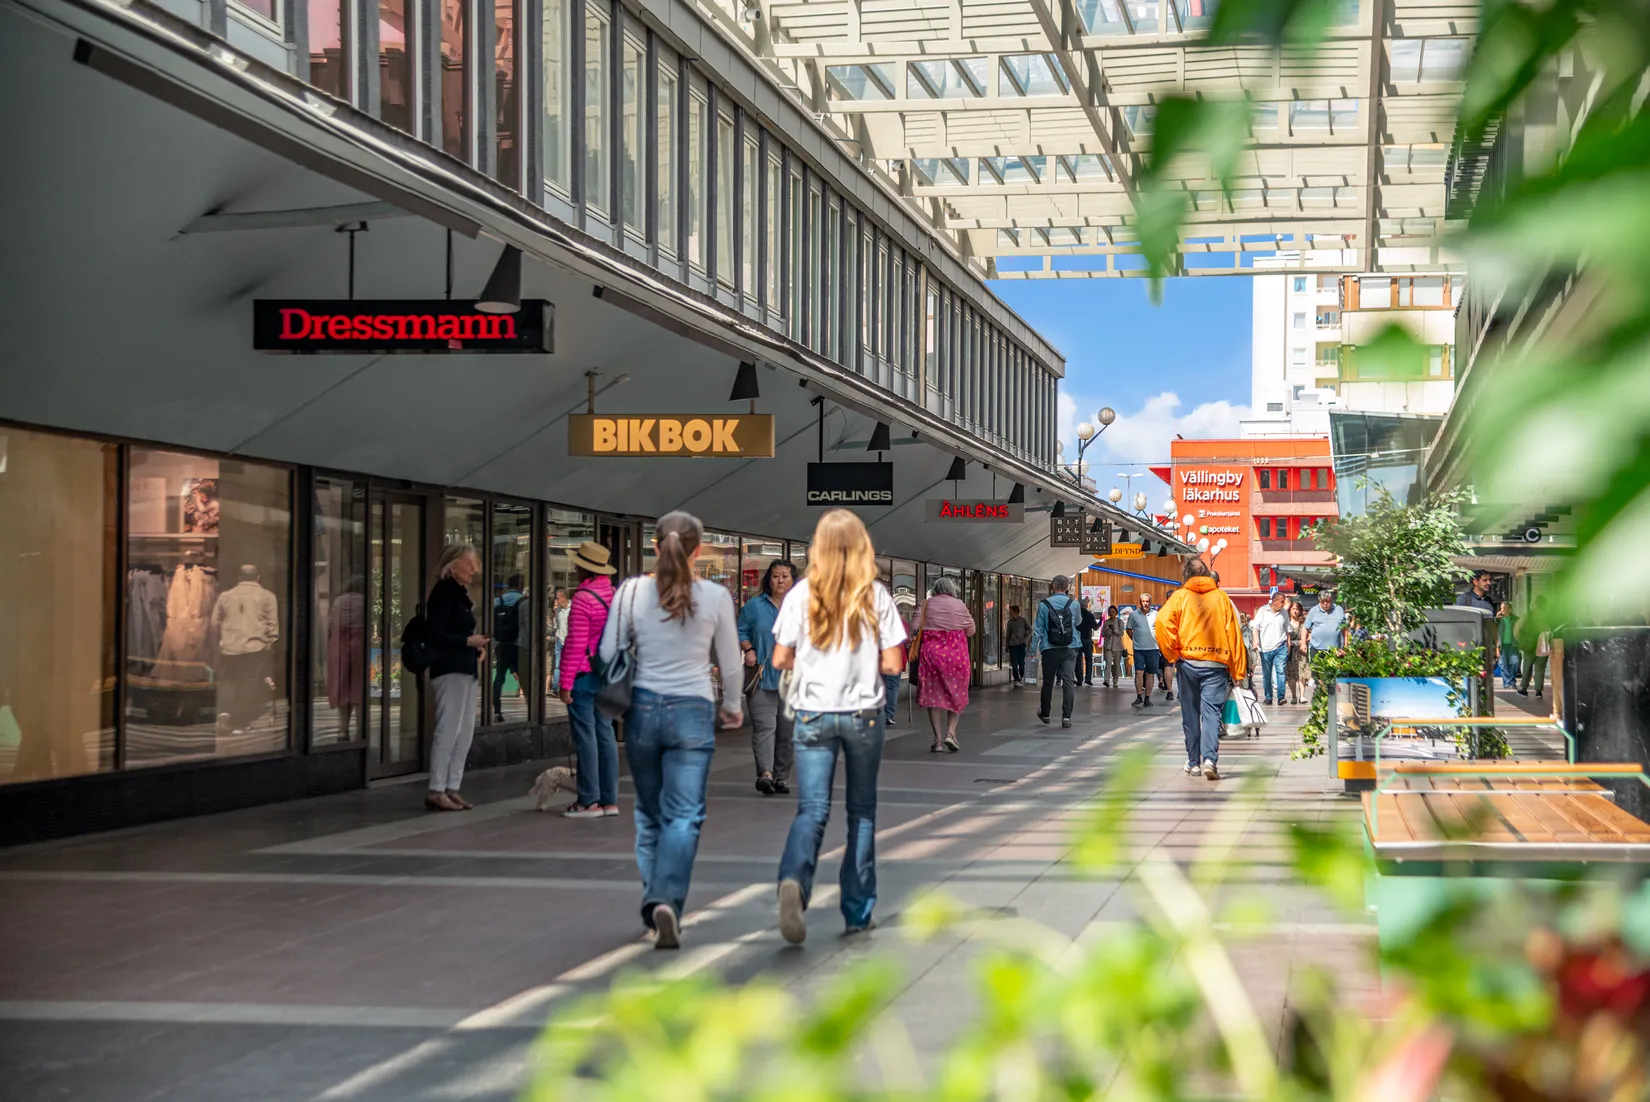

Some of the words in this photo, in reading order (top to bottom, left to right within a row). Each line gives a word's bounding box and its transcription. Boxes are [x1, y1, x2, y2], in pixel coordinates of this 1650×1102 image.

[279, 308, 518, 340] Dressmann
[1180, 470, 1243, 486] Vällingby
[807, 490, 892, 501] CARLINGS
[1183, 488, 1239, 502] läkarhus
[939, 499, 1009, 518] ÅHLÉNS
